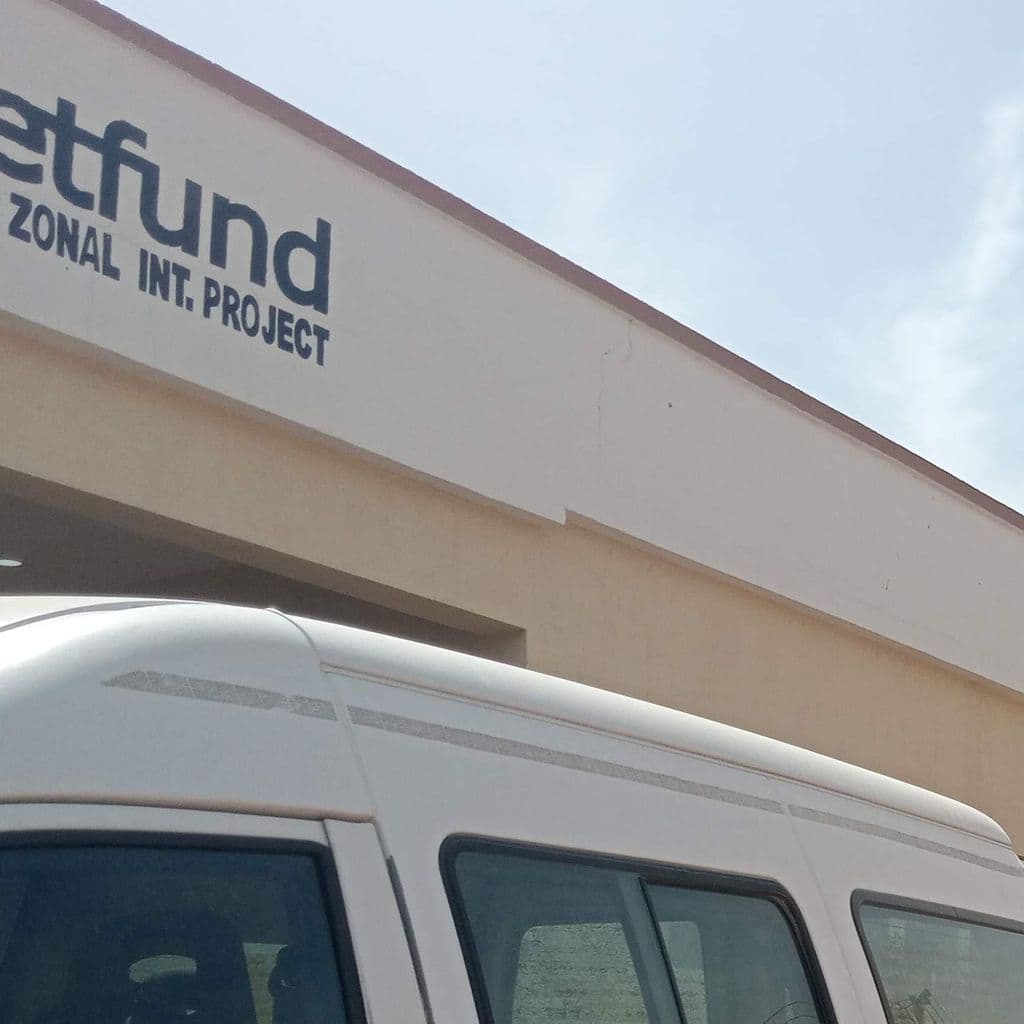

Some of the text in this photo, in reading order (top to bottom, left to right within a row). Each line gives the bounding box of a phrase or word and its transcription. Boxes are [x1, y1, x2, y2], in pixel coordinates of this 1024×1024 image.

[8, 192, 330, 366] ZONAL INT. PROJECT
